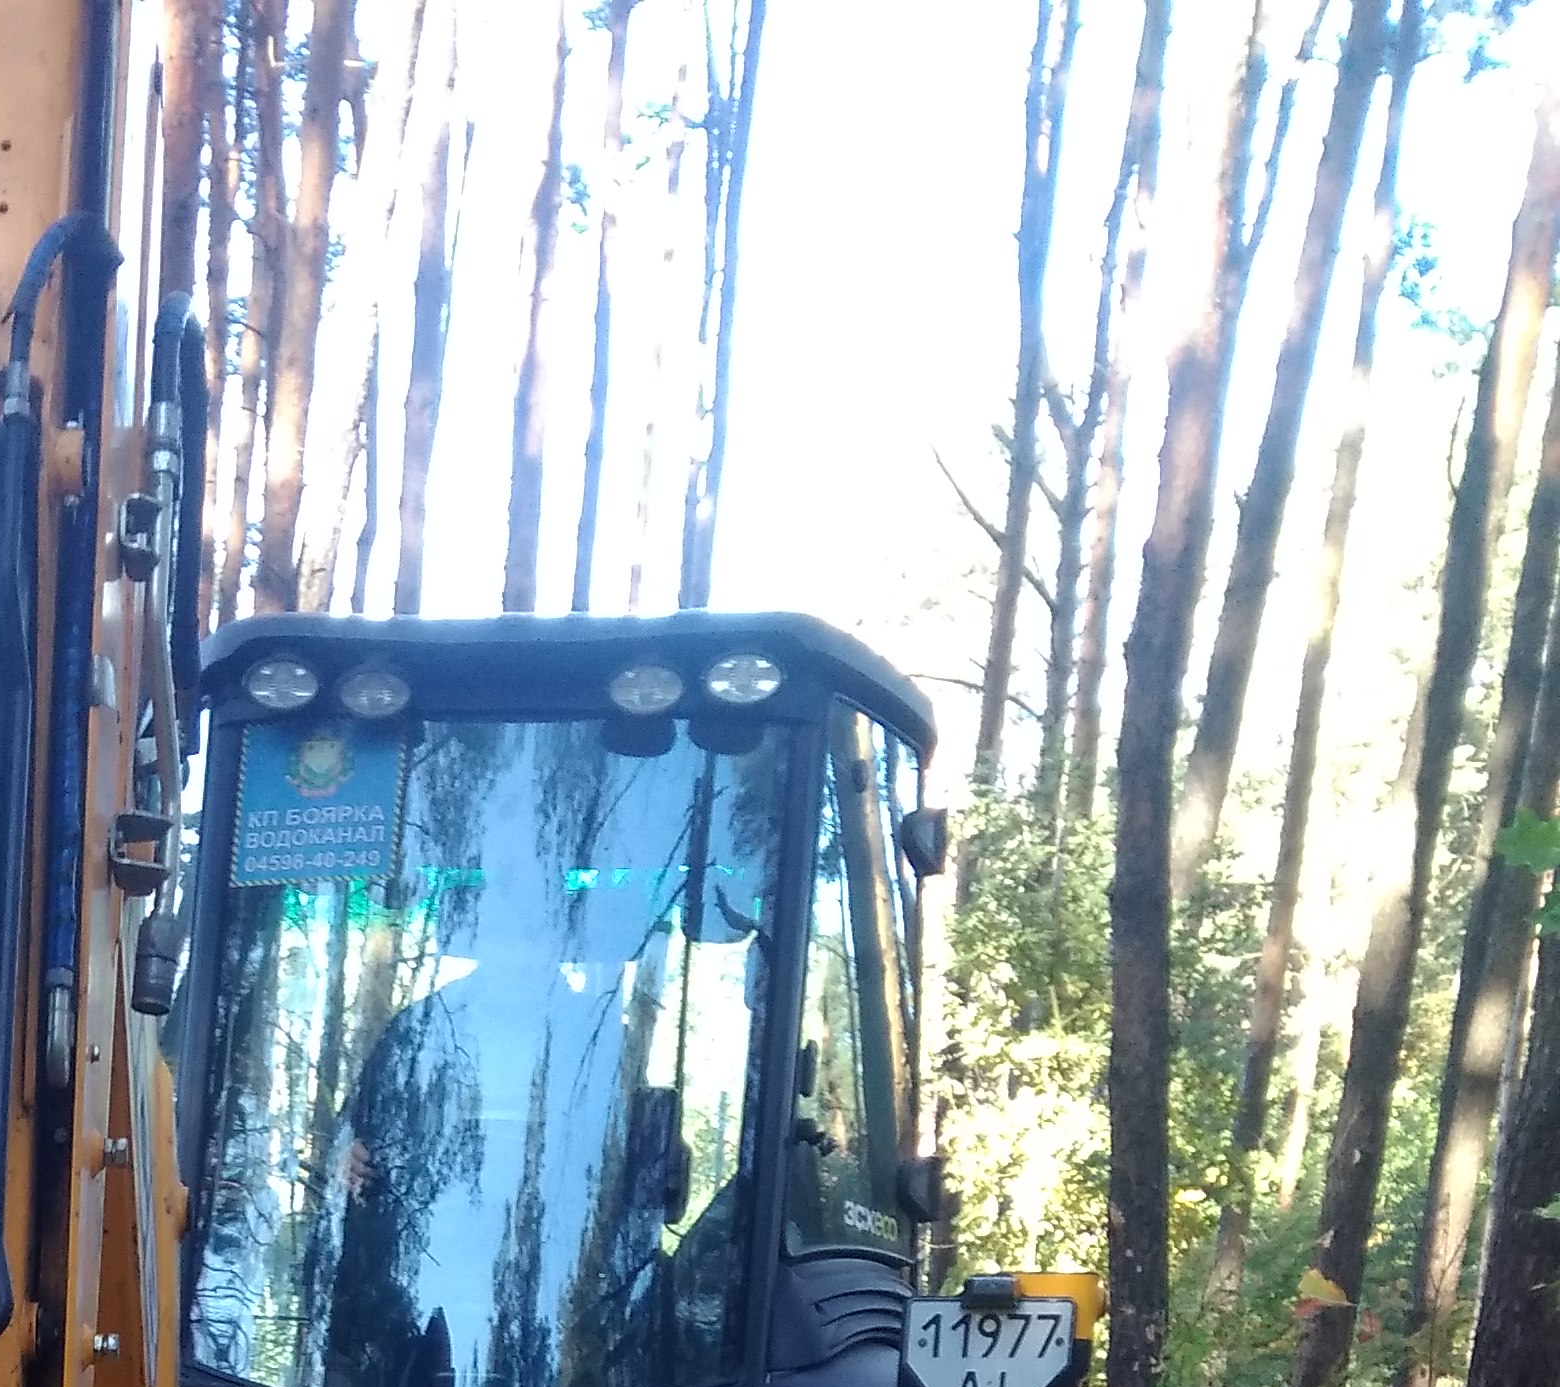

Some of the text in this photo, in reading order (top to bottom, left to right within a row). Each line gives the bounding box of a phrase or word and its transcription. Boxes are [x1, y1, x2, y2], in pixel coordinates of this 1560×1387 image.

[247, 805, 385, 828] КП БОЯРКА
[245, 825, 386, 850] ВОДОКАНАЛ
[920, 1313, 1063, 1359] 11977
